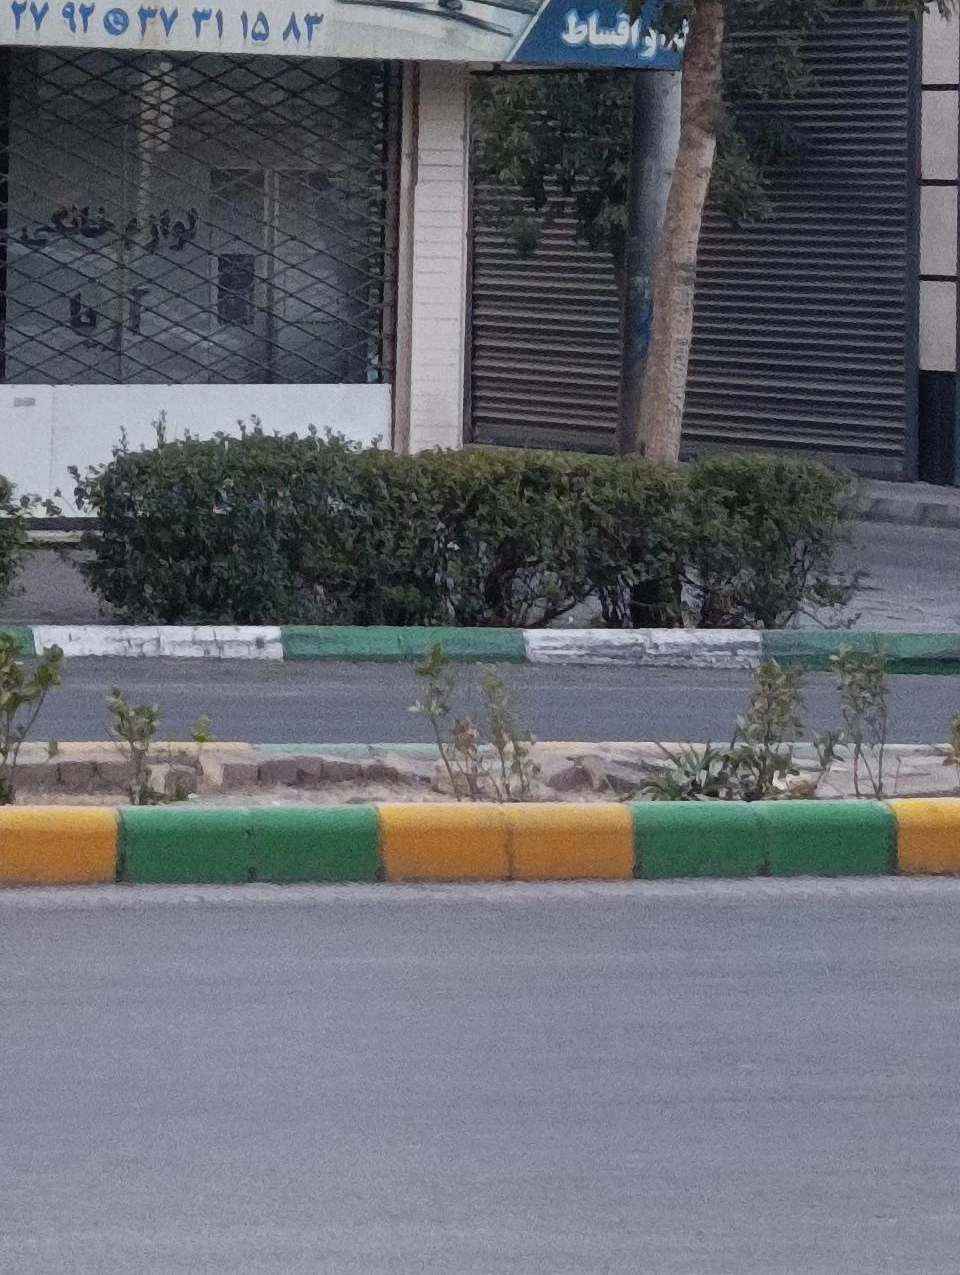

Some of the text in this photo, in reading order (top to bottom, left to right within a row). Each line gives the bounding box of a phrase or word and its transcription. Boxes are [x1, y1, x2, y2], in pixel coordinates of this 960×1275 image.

[11, 0, 49, 32] ۲۷
[62, 1, 96, 34] ۹۲
[138, 5, 179, 38] ۳۷
[192, 7, 224, 39] ۳۱
[241, 10, 269, 42] ۱۵
[283, 11, 325, 45] ۸۳
[561, 9, 641, 47] اقساط
